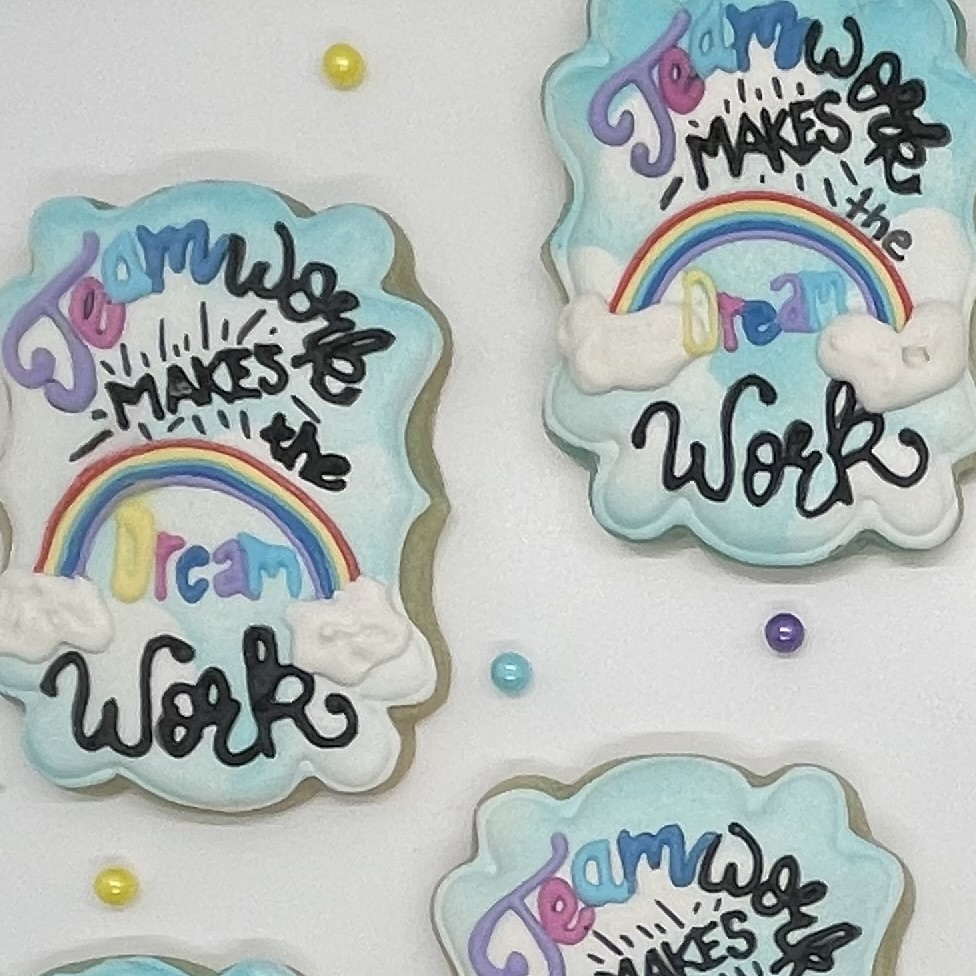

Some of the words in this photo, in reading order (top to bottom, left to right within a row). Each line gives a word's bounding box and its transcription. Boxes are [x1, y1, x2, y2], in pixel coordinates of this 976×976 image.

[686, 90, 852, 190] MAKES
[845, 188, 913, 261] the
[681, 267, 848, 357] Dream
[104, 345, 288, 430] MAKES
[261, 413, 350, 490] the
[632, 374, 928, 518] Work
[40, 625, 358, 765] Work
